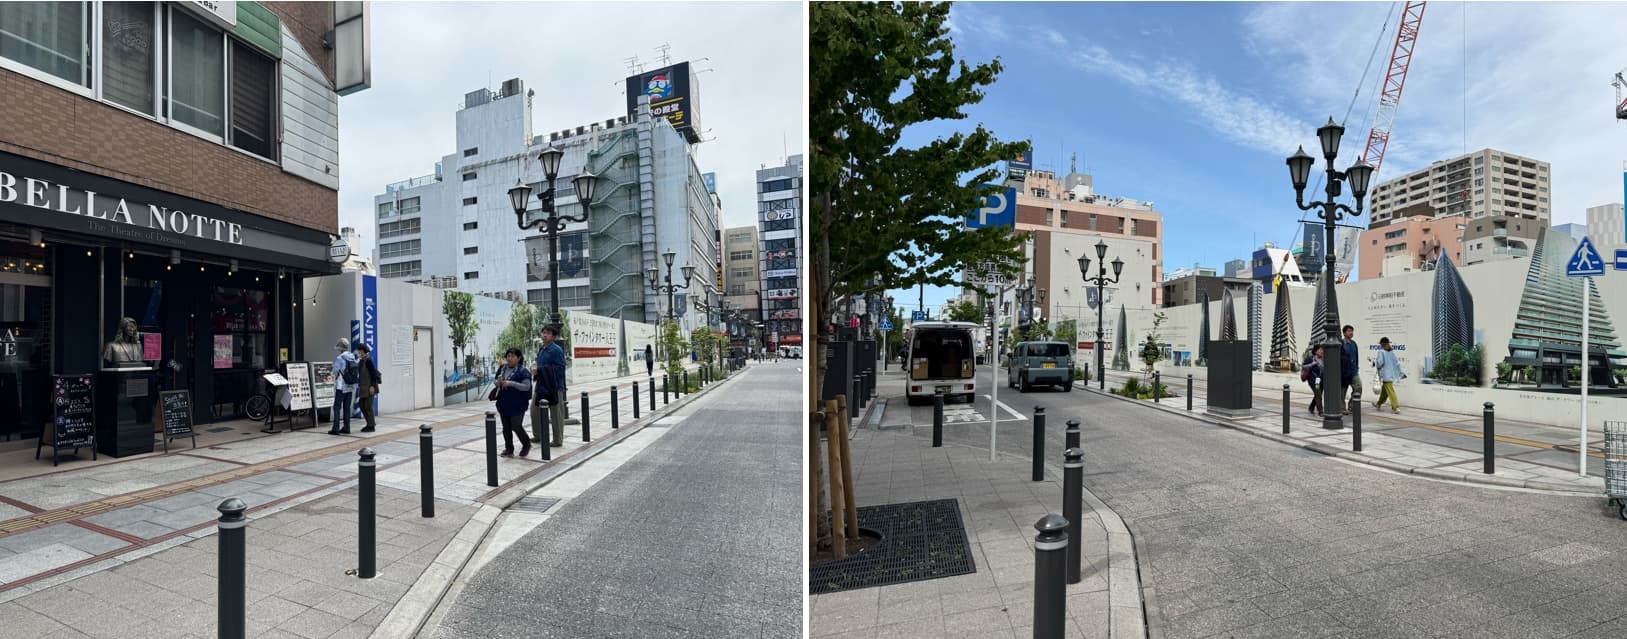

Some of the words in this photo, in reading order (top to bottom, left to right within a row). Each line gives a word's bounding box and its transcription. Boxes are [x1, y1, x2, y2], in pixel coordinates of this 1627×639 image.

[0, 171, 136, 225] BELLA
[148, 203, 243, 245] NOTTE
[979, 192, 1008, 225] P
